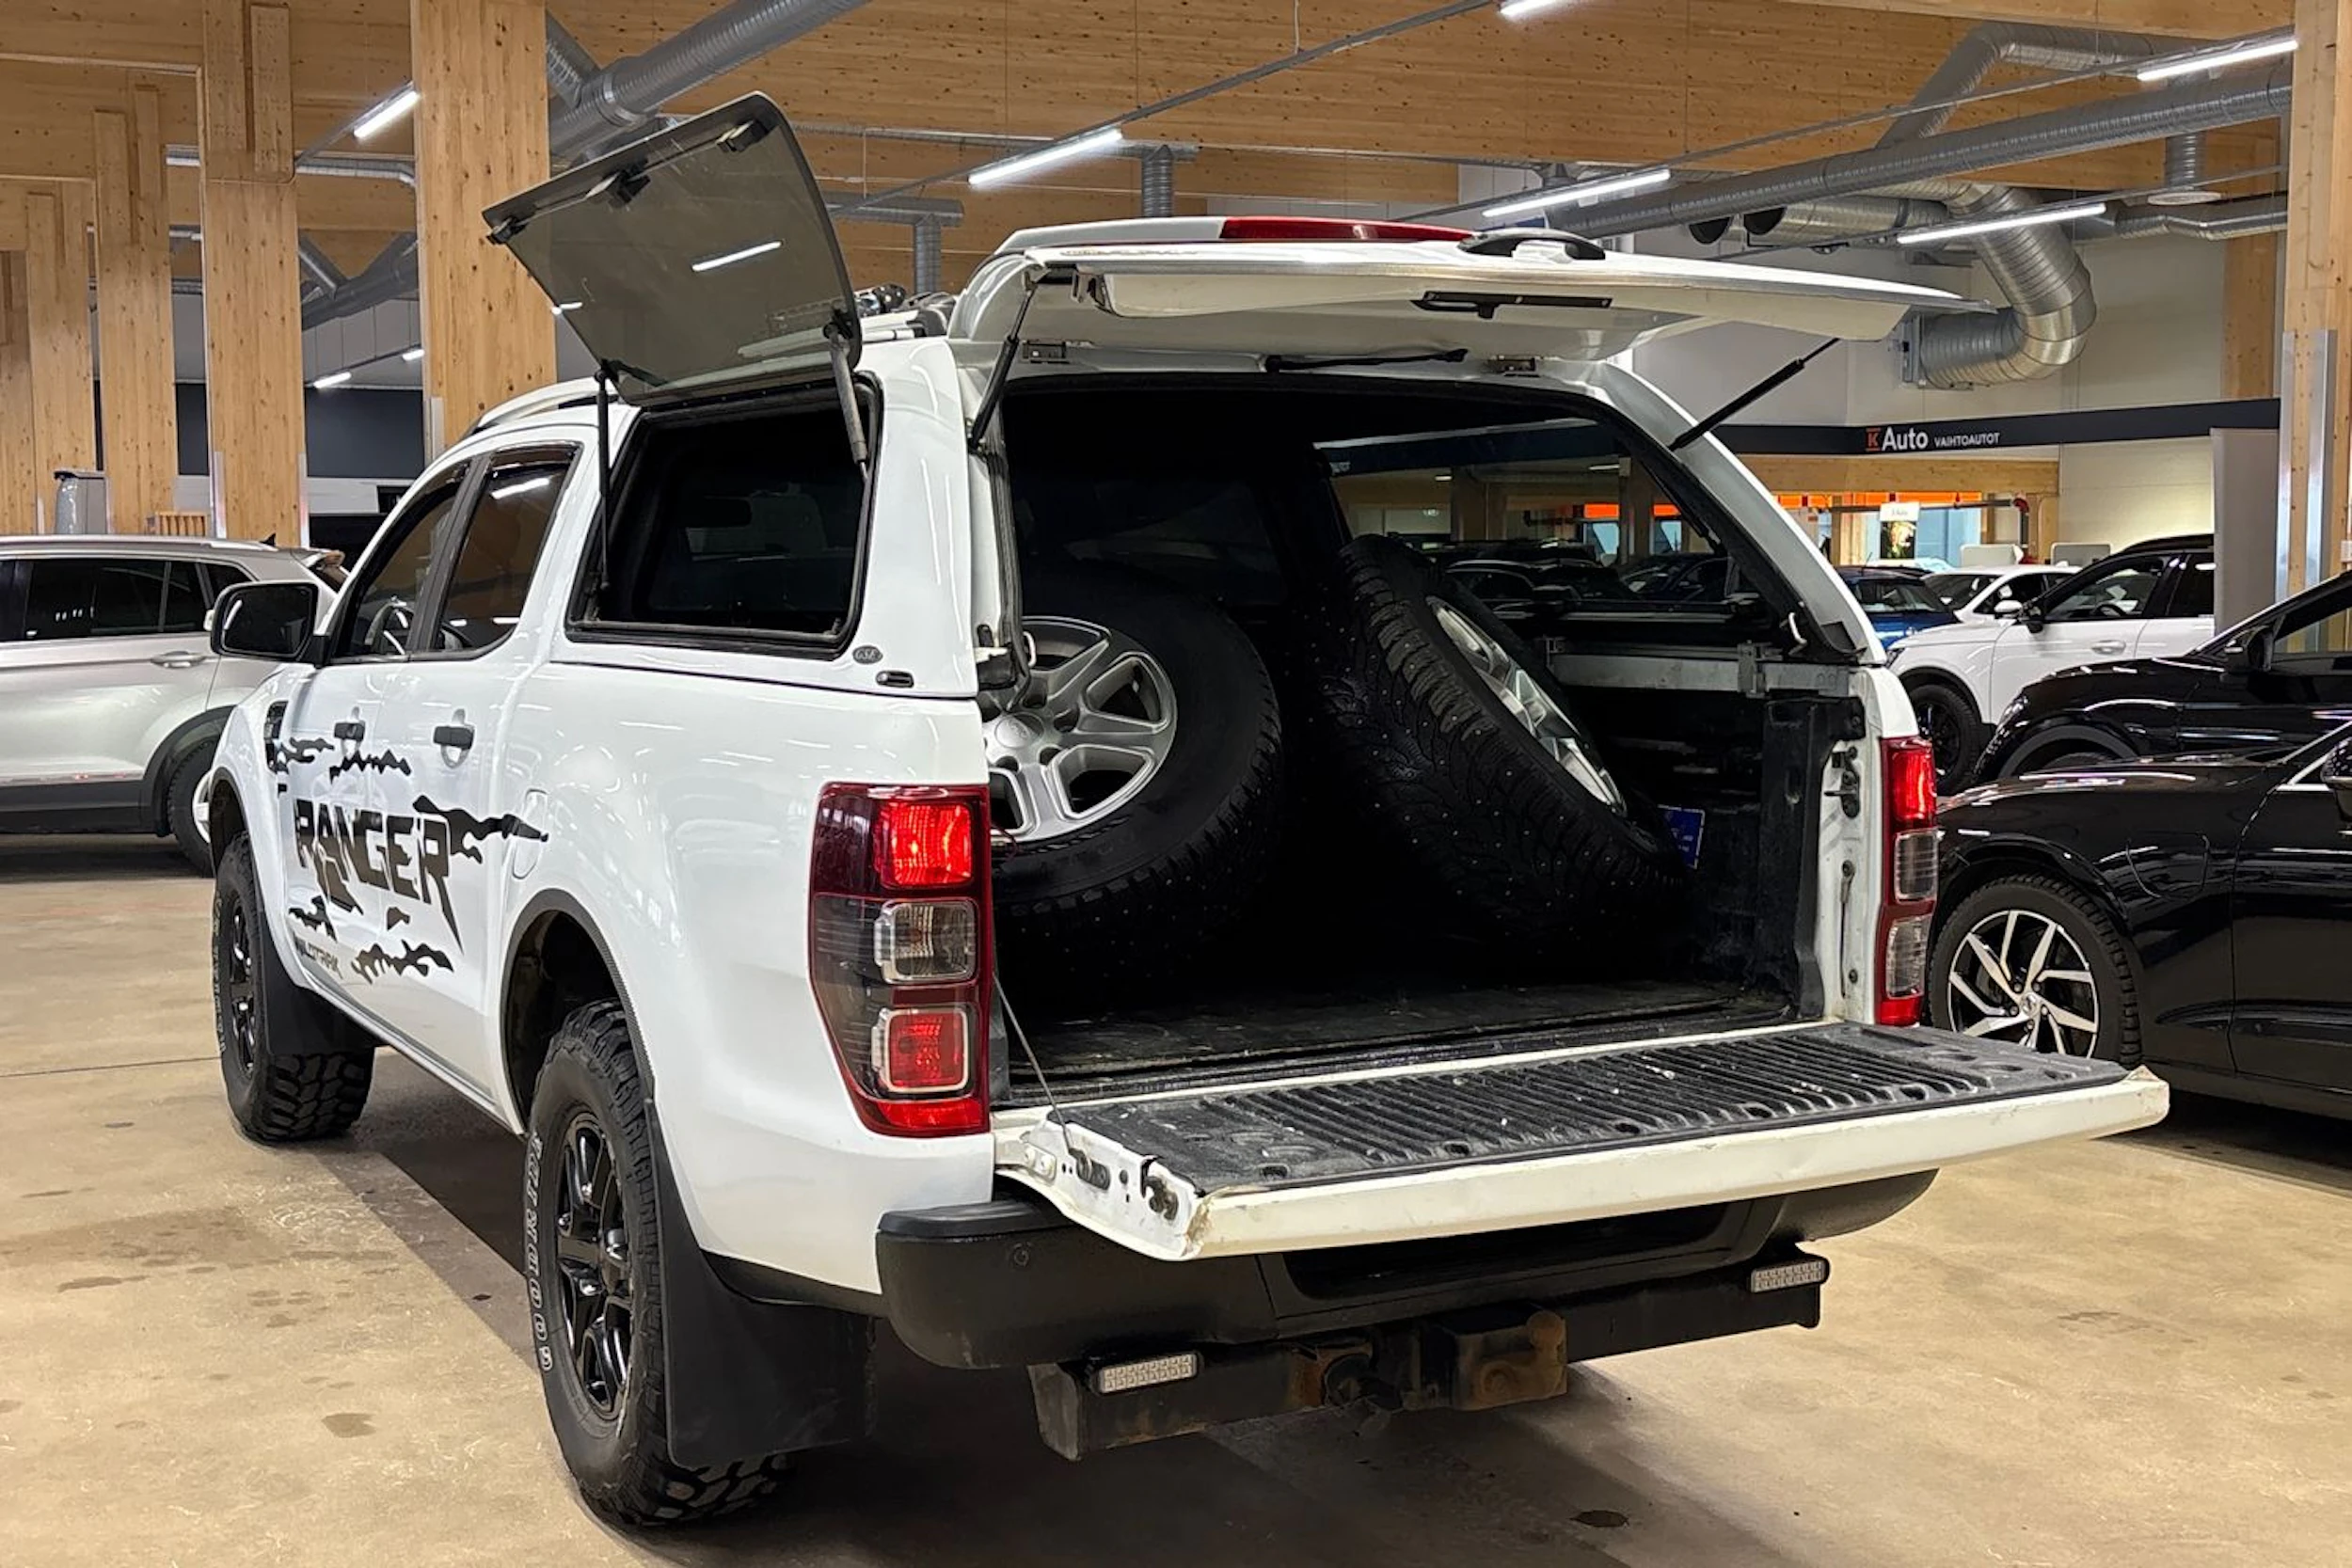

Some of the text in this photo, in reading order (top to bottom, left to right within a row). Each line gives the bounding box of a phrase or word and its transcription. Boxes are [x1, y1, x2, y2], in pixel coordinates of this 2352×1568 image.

[1883, 426, 1929, 451] Auto
[1934, 433, 2000, 448] VAIHTOAUTOT
[294, 799, 463, 953] RANGER
